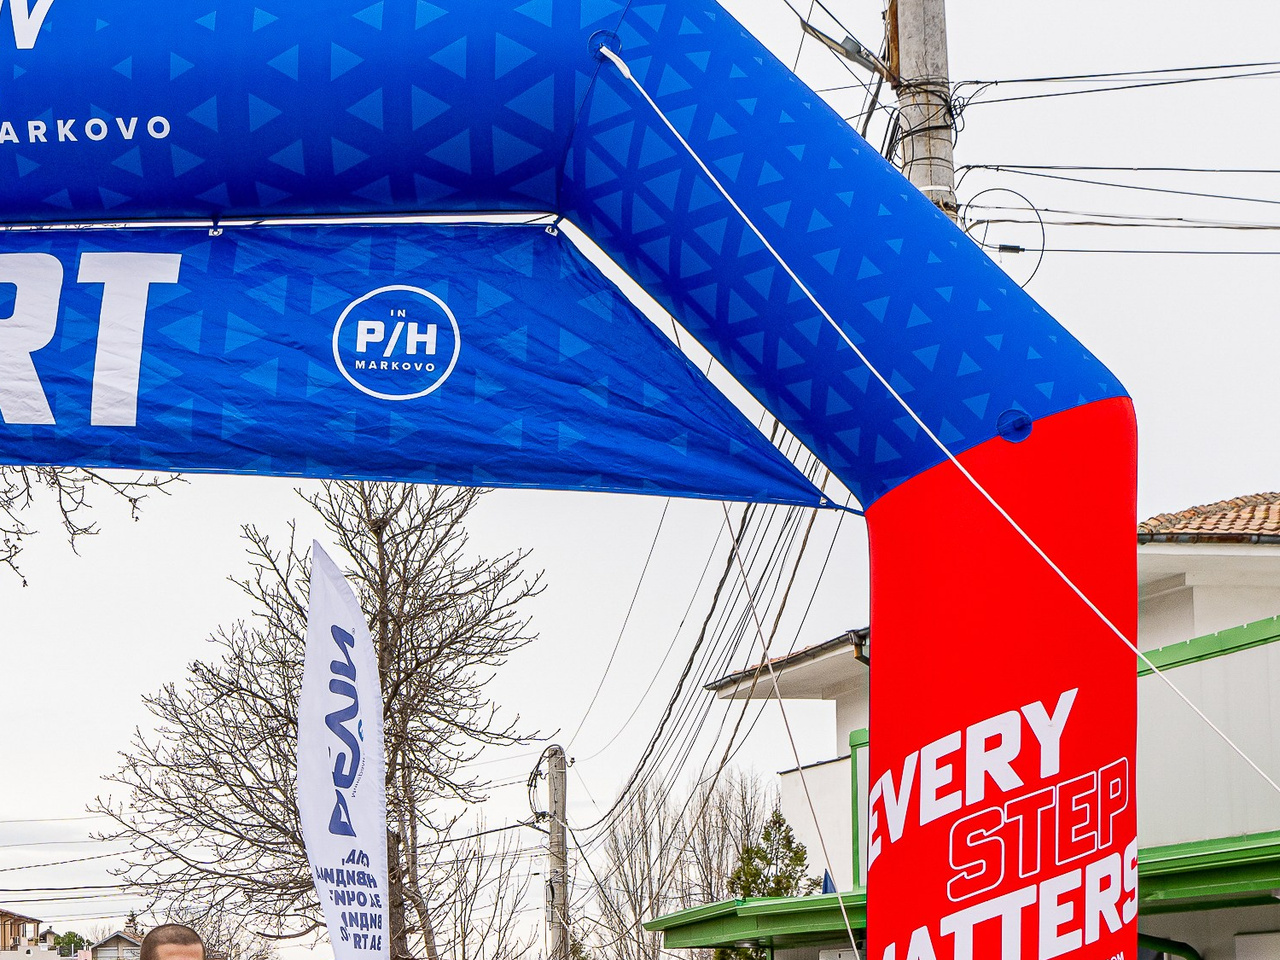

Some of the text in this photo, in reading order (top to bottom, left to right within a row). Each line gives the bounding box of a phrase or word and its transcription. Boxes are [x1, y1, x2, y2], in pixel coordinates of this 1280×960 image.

[390, 309, 406, 318] IN
[356, 320, 438, 358] P/H
[355, 360, 435, 372] MARKOVO
[868, 687, 1079, 871] EVERY
[947, 757, 1128, 901] STEP
